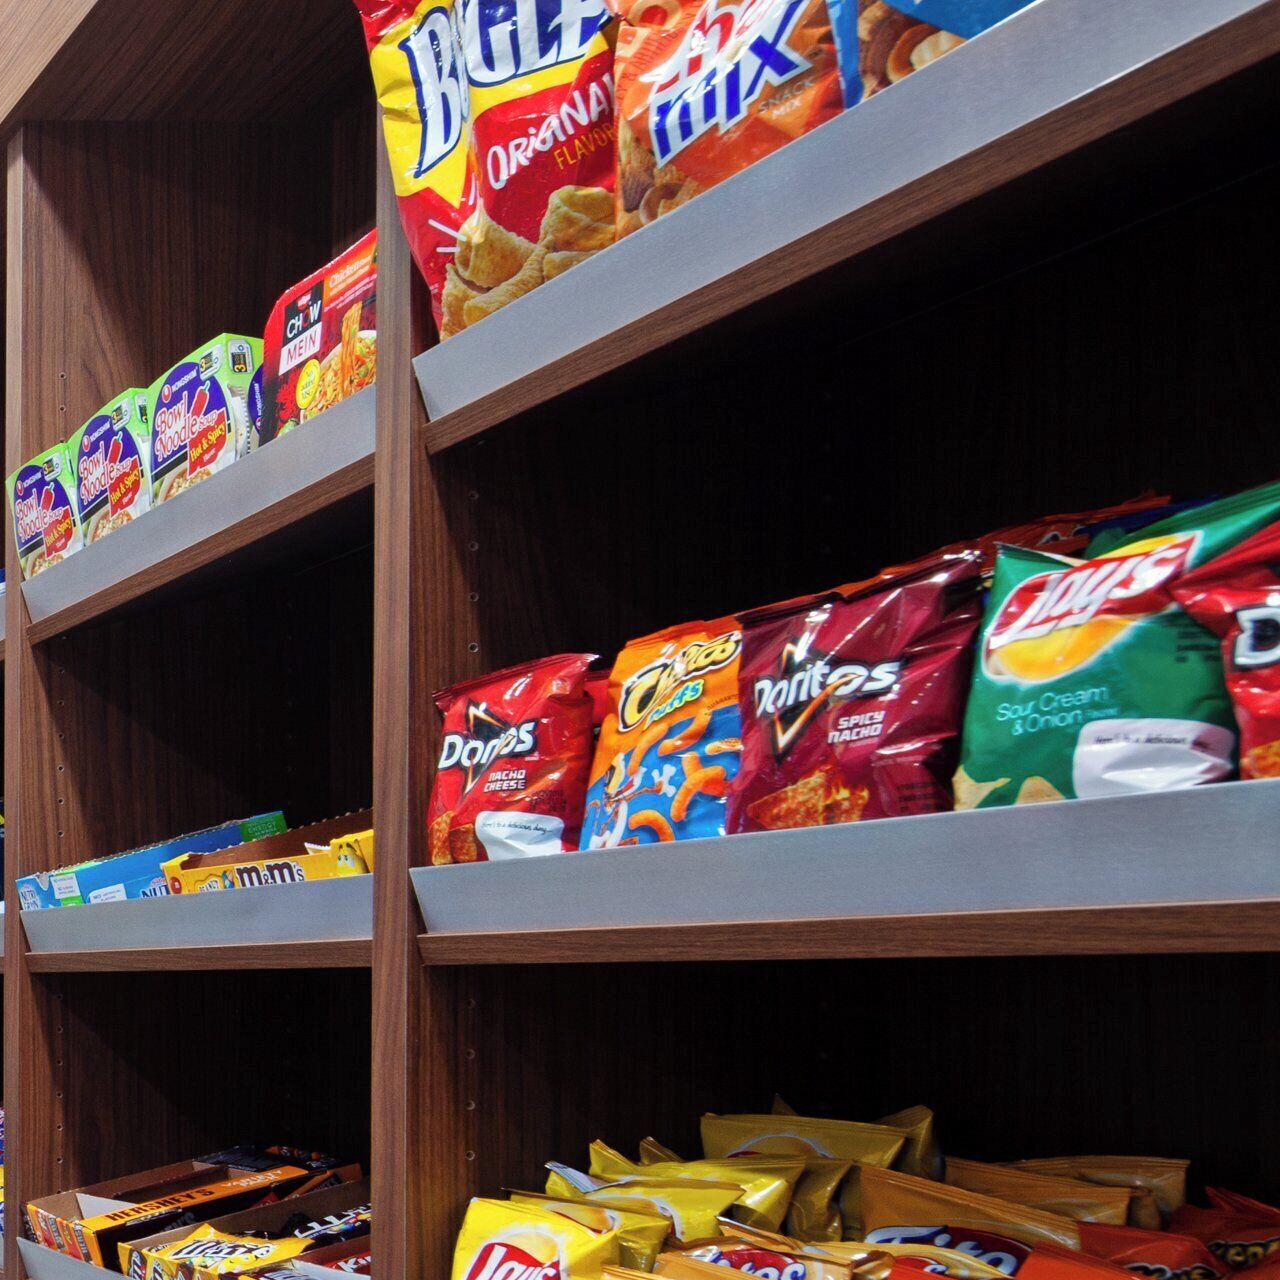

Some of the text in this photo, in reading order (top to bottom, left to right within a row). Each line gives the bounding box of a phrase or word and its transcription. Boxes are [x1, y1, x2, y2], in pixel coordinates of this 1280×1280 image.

[287, 332, 316, 364] MEIN
[996, 686, 1109, 721] Sour Cream
[839, 711, 885, 731] SPICY
[1028, 708, 1084, 732] Onion
[484, 780, 526, 793] CHEESE
